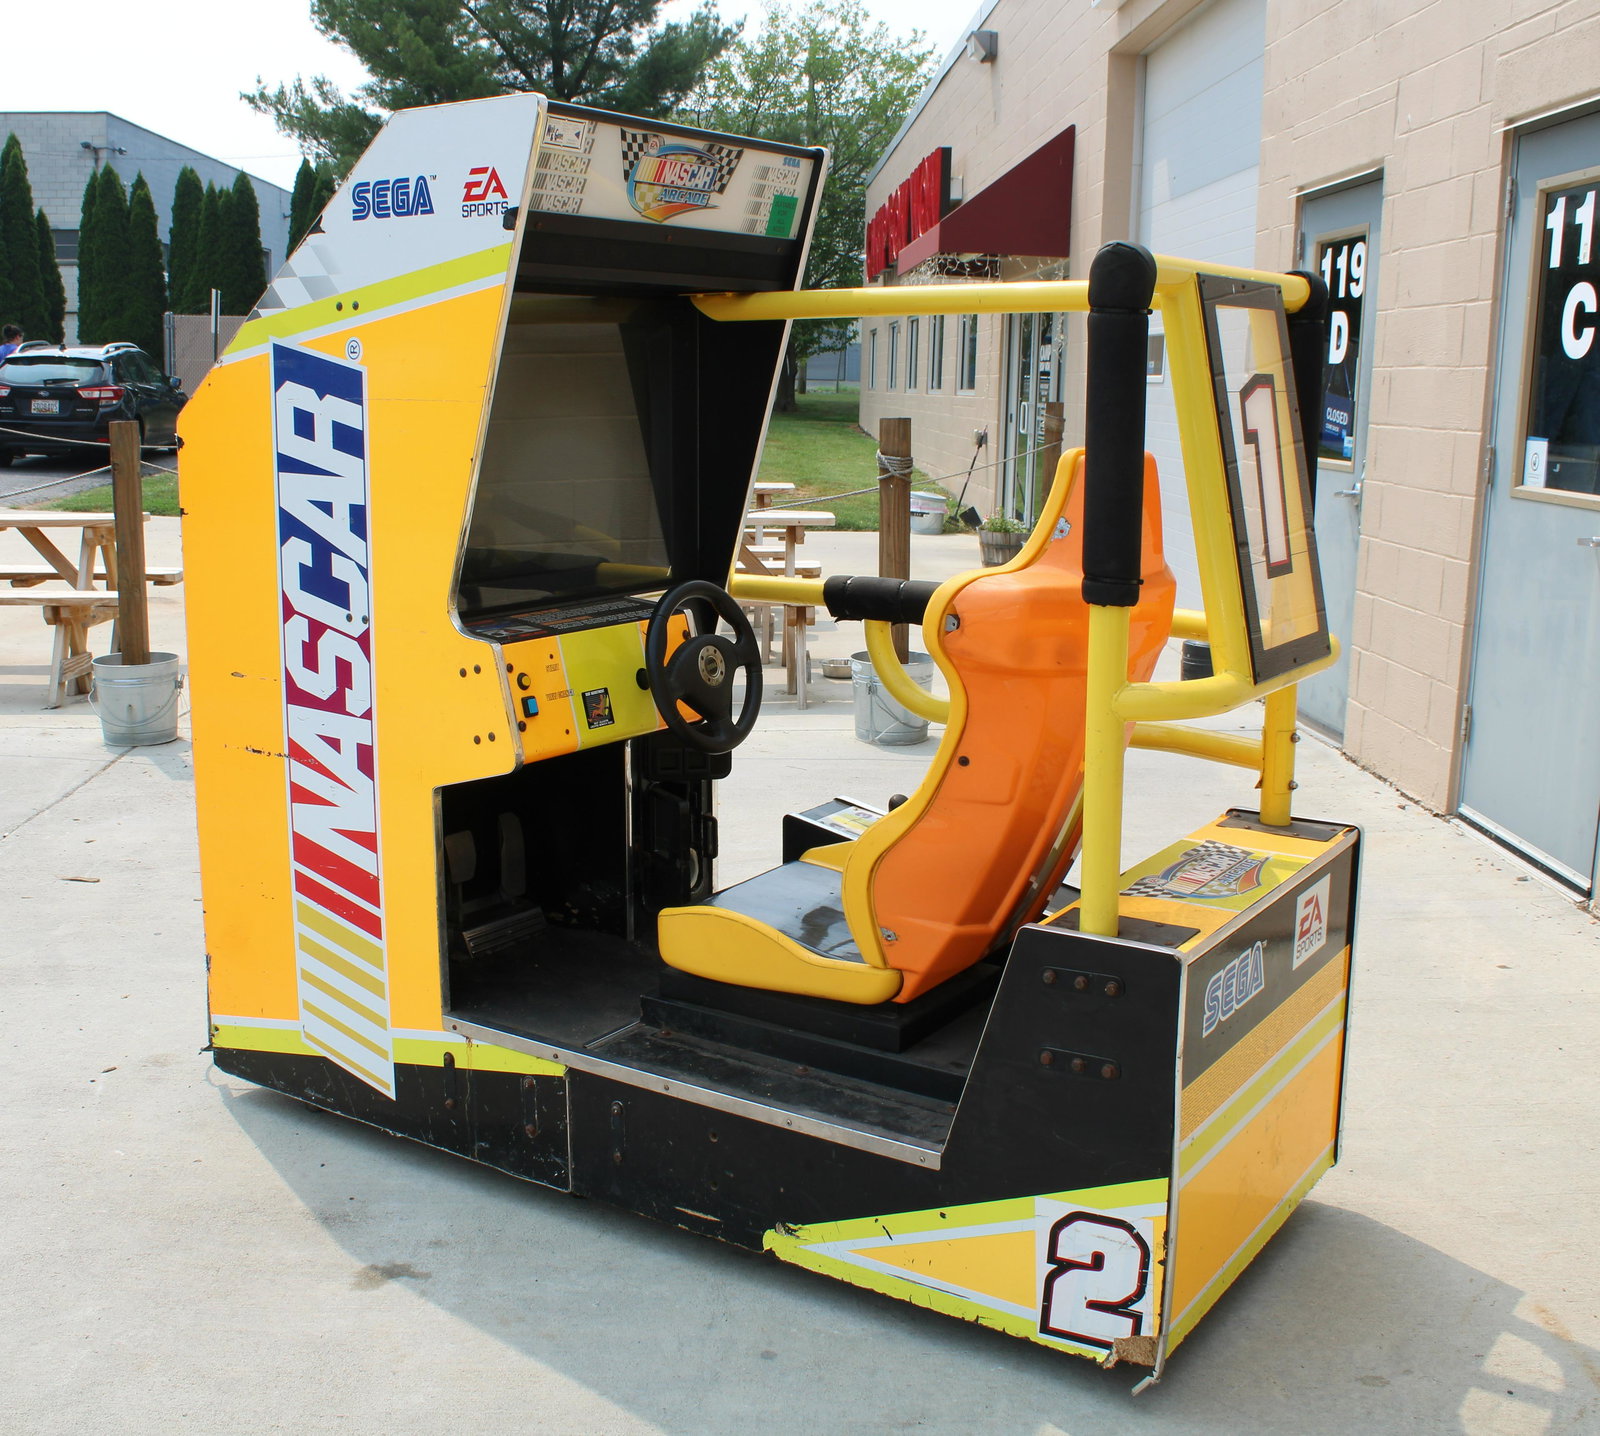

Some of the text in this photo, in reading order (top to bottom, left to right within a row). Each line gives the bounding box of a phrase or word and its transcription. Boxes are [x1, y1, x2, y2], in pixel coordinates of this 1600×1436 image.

[548, 153, 590, 174] NASCAR
[663, 159, 715, 190] NASCAR
[767, 168, 798, 185] NASCAR
[352, 175, 434, 221] SEGA
[462, 166, 509, 202] EA
[544, 173, 585, 194] NASCAR
[658, 188, 710, 206] ARCADE
[462, 201, 509, 218] SPORTS
[540, 194, 583, 214] NASCAR
[1321, 241, 1366, 299] 119
[1328, 310, 1349, 365] D
[1561, 281, 1597, 360] C
[1326, 407, 1349, 426] CLOSED
[1240, 374, 1293, 579] 1
[276, 380, 376, 875] NASCAR
[1297, 893, 1323, 942] EA
[1296, 926, 1323, 960] SPORTS
[1203, 940, 1265, 1038] SEGA
[1039, 1210, 1150, 1351] 2
